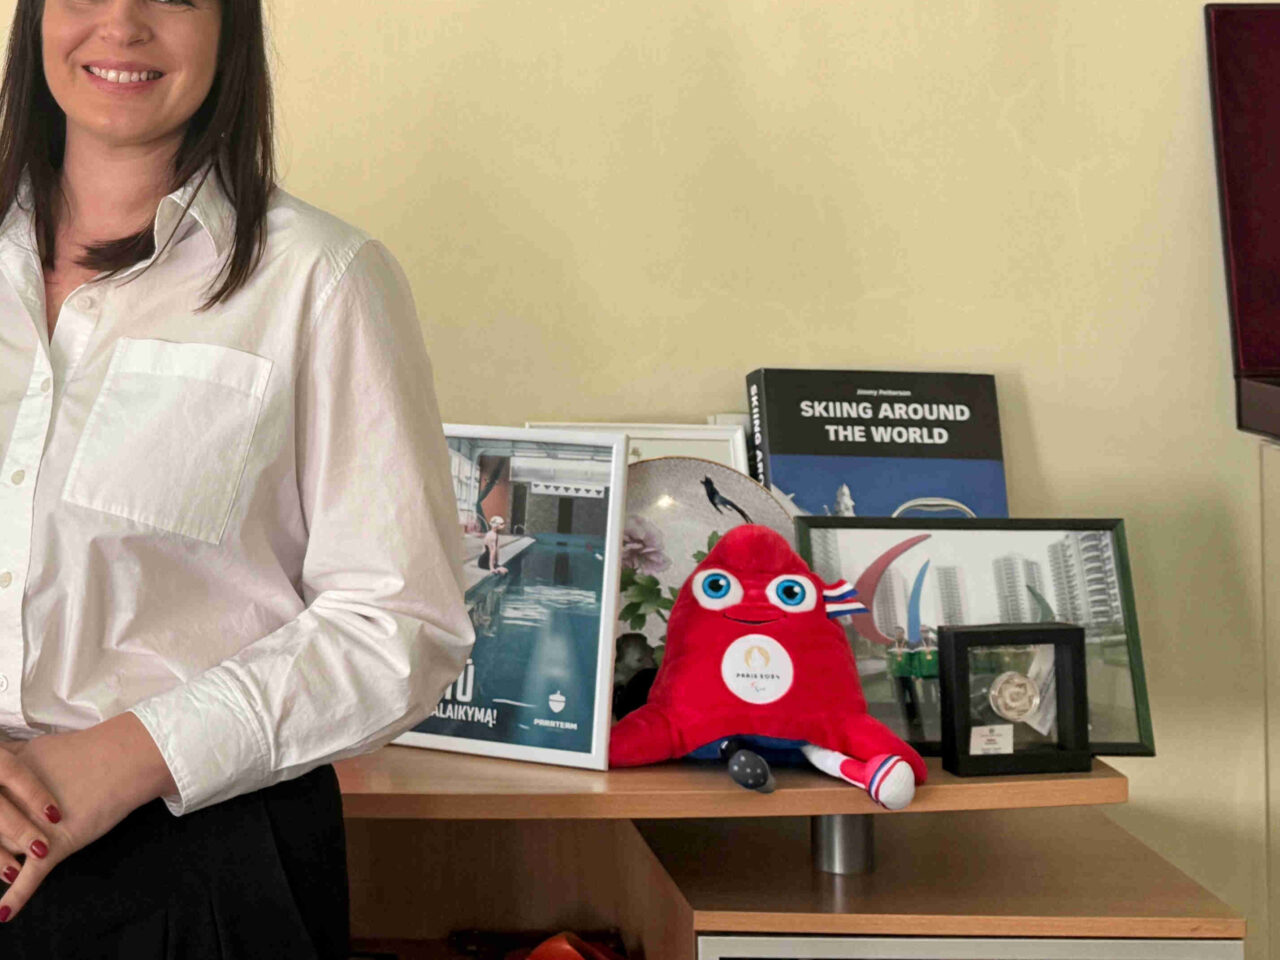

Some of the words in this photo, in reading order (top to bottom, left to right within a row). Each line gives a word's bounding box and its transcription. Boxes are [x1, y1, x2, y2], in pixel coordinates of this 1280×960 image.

[750, 384, 762, 446] SKIING
[800, 400, 873, 419] SKIING
[878, 402, 971, 421] AROUND
[825, 424, 867, 442] THE
[870, 426, 949, 444] WORLD
